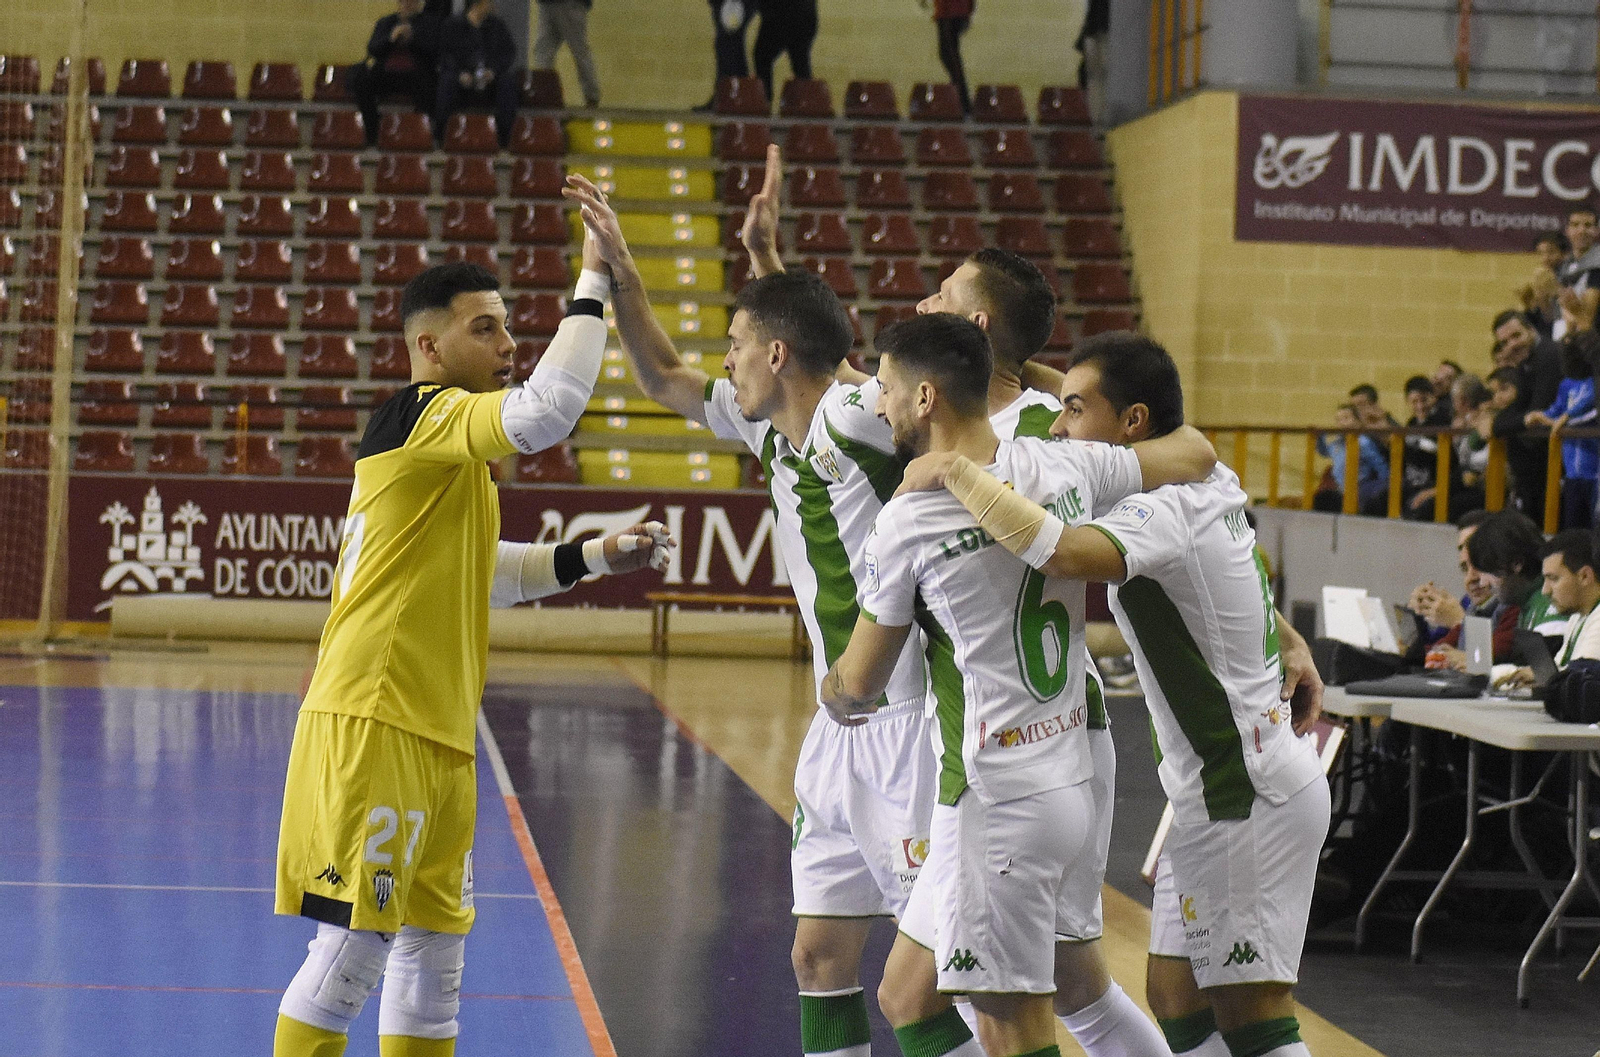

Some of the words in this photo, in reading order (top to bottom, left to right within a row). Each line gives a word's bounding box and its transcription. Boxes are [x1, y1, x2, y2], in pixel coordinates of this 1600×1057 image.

[1348, 131, 1600, 201] IMDEC
[1254, 200, 1335, 221] Instituto
[1339, 203, 1437, 228] Municipal
[1440, 209, 1465, 226] de
[1470, 208, 1560, 231] Deportes
[215, 558, 250, 594] DE
[1013, 562, 1070, 703] 6
[363, 805, 426, 867] 27
